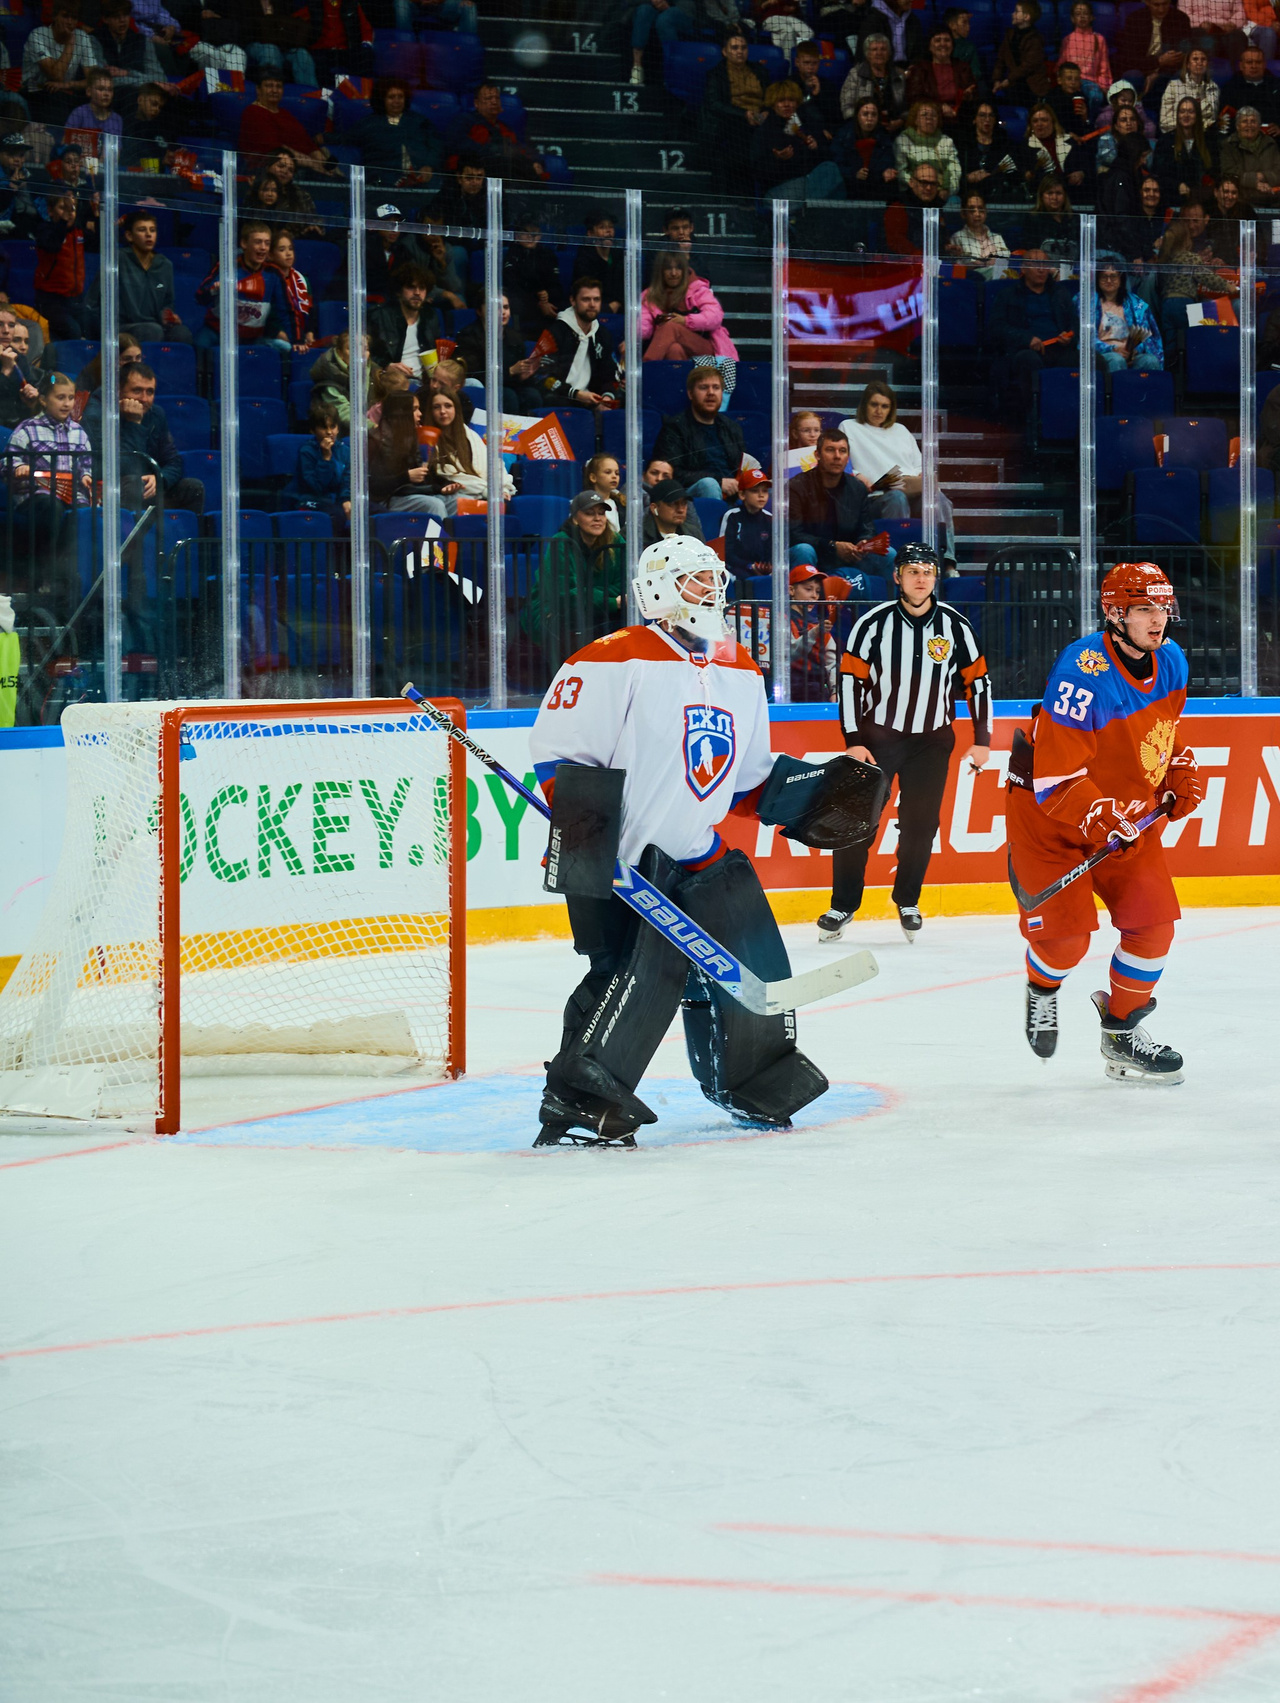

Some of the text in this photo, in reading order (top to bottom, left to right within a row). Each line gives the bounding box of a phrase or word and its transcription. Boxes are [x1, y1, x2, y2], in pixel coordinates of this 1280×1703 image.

[572, 33, 598, 53] 14
[612, 91, 639, 112] 13
[658, 150, 686, 171] 12
[707, 213, 728, 236] 11
[1148, 586, 1173, 595] РОЛЬФ
[547, 677, 583, 710] 83
[1053, 681, 1094, 721] 33
[420, 700, 496, 765] SHADOW
[687, 709, 732, 737] СХЛ
[1062, 859, 1090, 888] CCM
